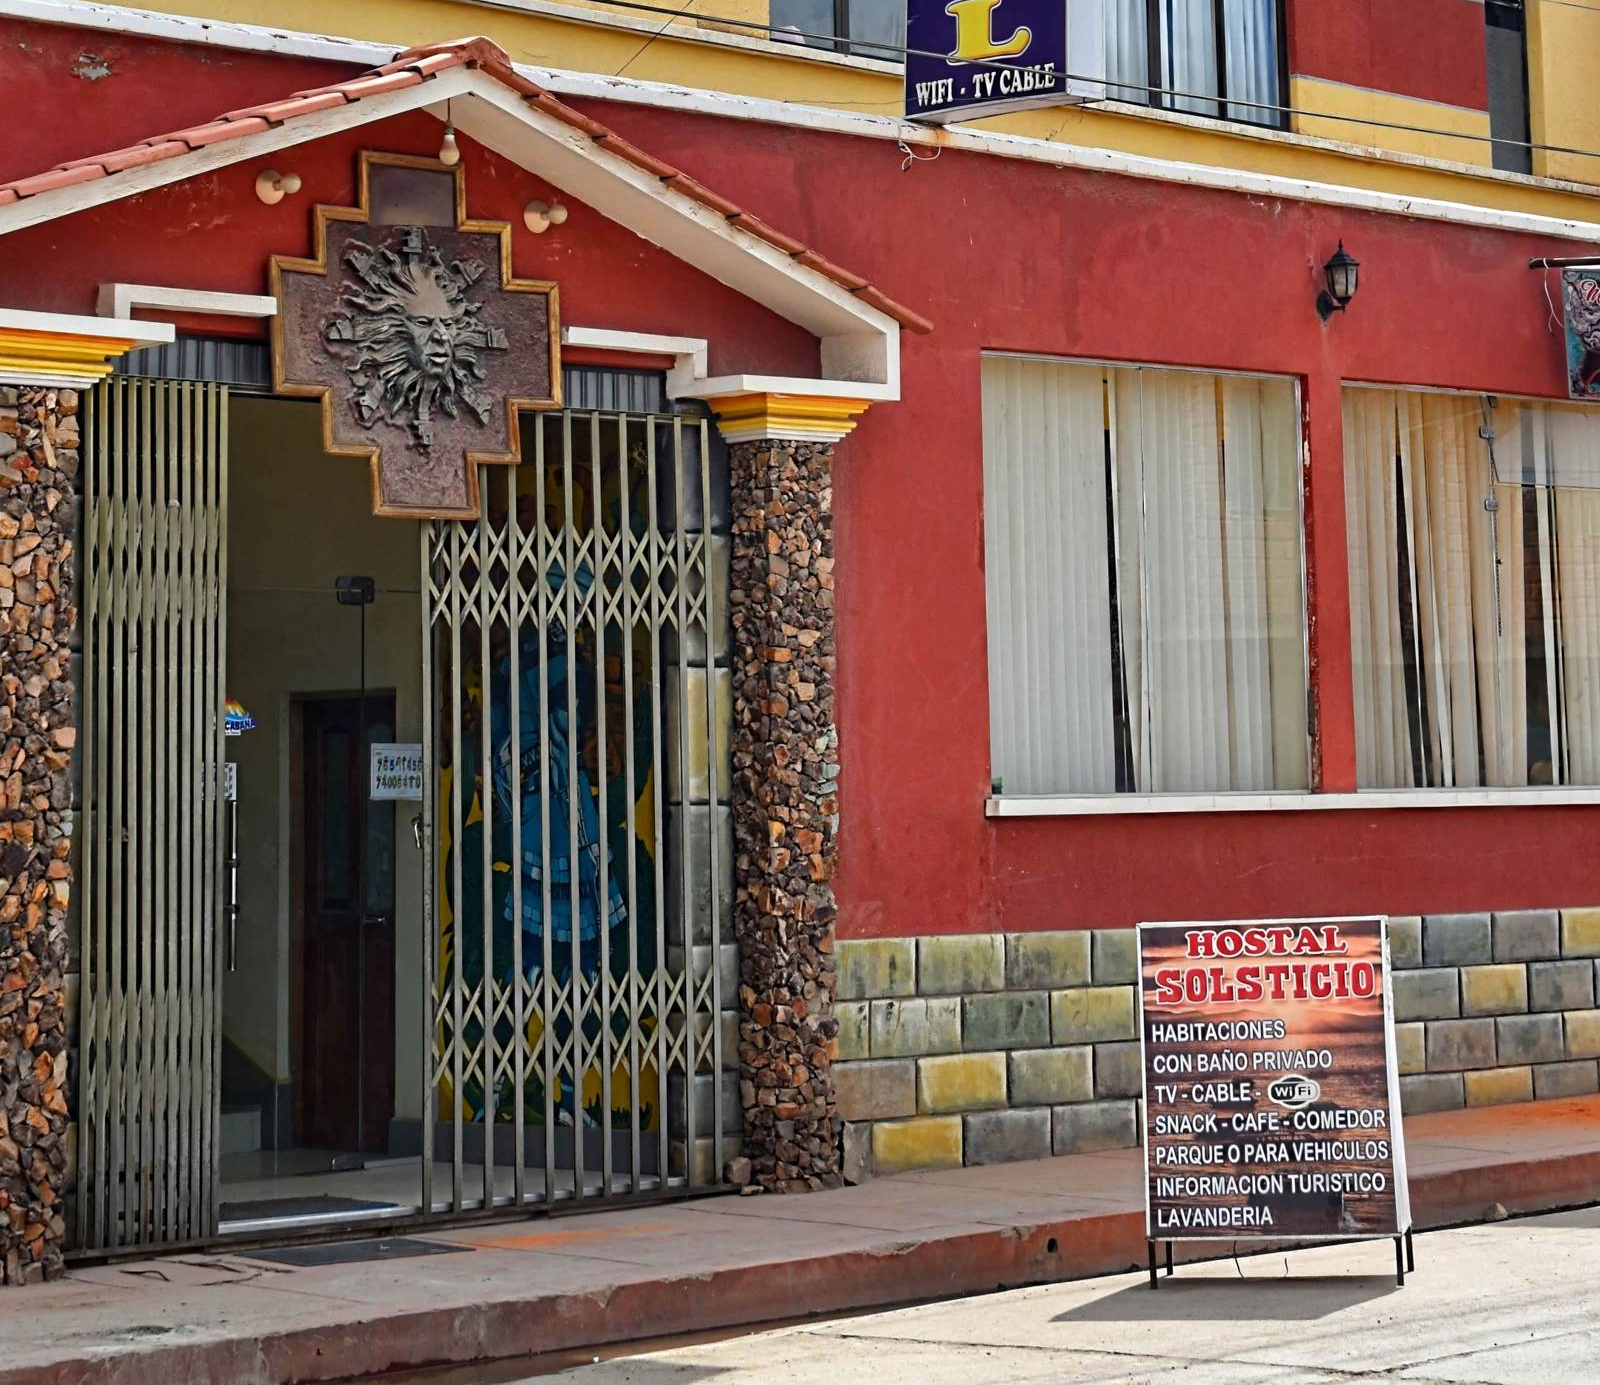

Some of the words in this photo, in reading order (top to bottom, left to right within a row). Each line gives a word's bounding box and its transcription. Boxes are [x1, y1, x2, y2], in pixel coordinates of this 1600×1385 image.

[915, 78, 954, 107] WIFI
[972, 71, 997, 98] TV
[999, 62, 1056, 95] CABLE
[224, 718, 256, 731] CABANA
[1185, 926, 1347, 958] HOSTAL
[1155, 961, 1375, 1005] SOLSTICIO
[1151, 1020, 1285, 1043] HABITACIONES
[1153, 1054, 1192, 1073] CON
[1197, 1049, 1248, 1072] BAÑO
[1253, 1049, 1332, 1070] PRIVADO
[1155, 1085, 1178, 1104] TV
[1192, 1083, 1251, 1102] CABLE
[1274, 1085, 1312, 1098] WiFi
[1155, 1114, 1218, 1134] SNACK
[1232, 1112, 1280, 1132] CAFE
[1293, 1109, 1386, 1129] COMEDOR
[1156, 1145, 1224, 1165] PARQUE
[1228, 1144, 1240, 1163] O
[1244, 1143, 1289, 1162] PARA
[1292, 1140, 1389, 1162] VEHICULOS
[1157, 1175, 1283, 1197] INFORMACION
[1287, 1172, 1386, 1194] TURISTICO
[1158, 1206, 1274, 1228] LAVANDERIA
